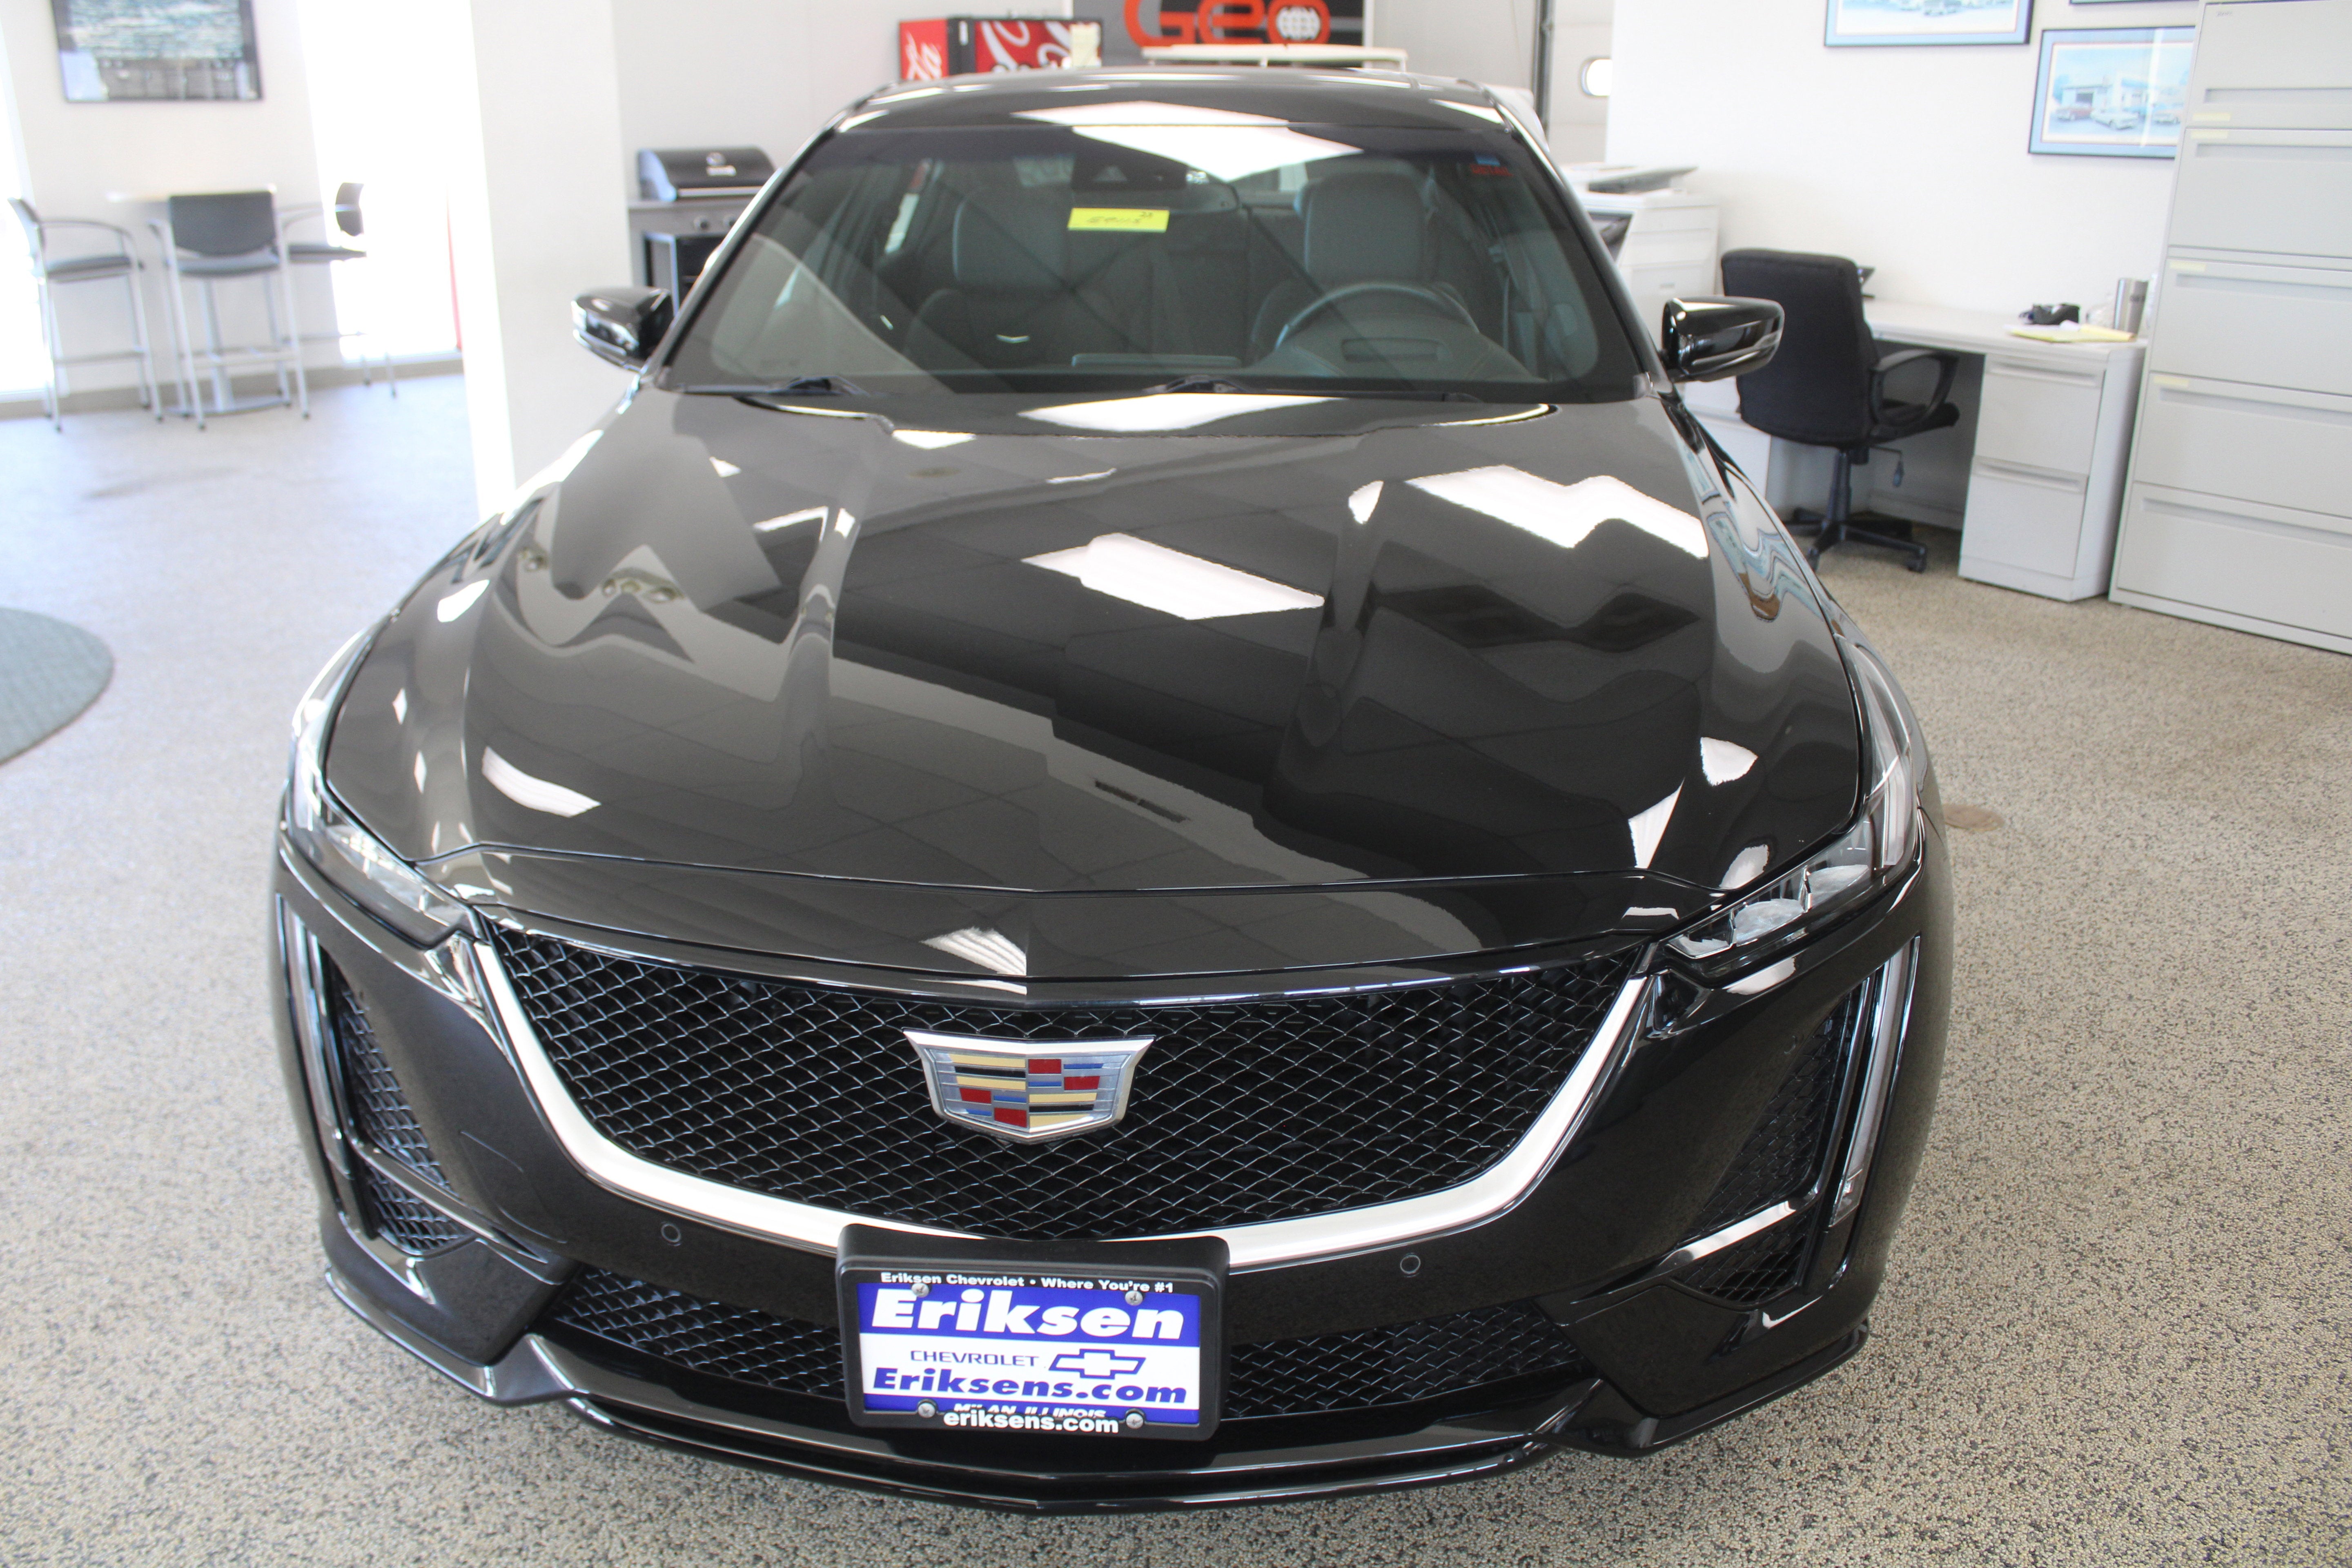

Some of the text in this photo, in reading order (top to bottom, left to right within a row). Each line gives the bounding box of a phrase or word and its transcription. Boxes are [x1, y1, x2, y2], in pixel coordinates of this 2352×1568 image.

[1124, 0, 1331, 48] Geo
[881, 1272, 1173, 1293] Eriksen Chevrolet Where You're #1
[872, 1288, 1184, 1339] Eriksen
[910, 1350, 1040, 1367] CHEVROLET
[873, 1367, 1187, 1403] Eriksens.com
[943, 1409, 1118, 1433] eriksens.com
